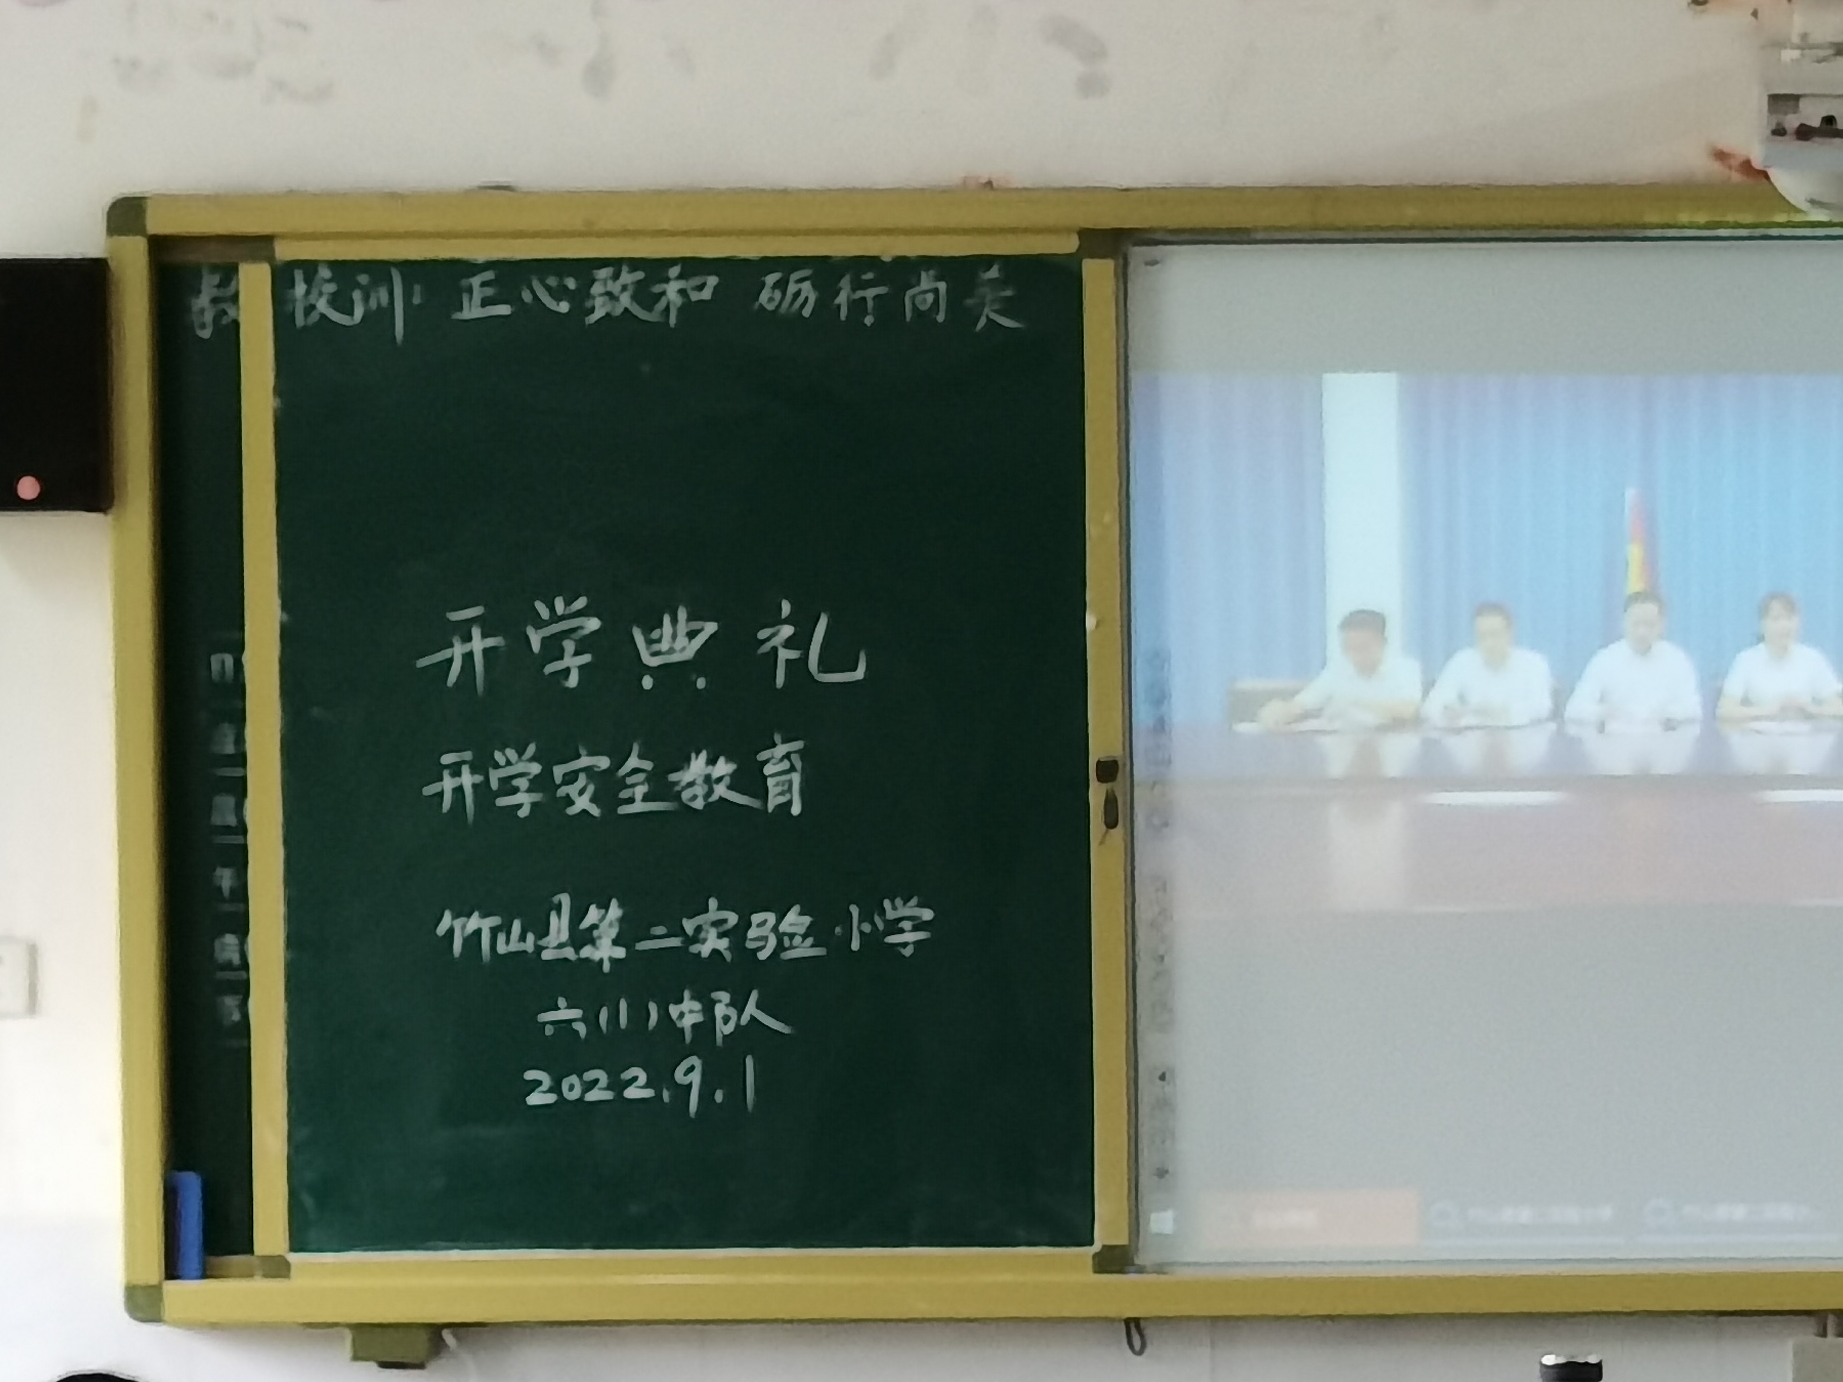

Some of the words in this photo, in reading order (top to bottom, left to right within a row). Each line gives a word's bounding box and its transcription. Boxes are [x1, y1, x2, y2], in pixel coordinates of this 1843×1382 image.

[415, 595, 867, 696] 开学典礼
[421, 732, 806, 826] 开学安全教育
[435, 893, 935, 974] 竹山县第二实验小学
[523, 1055, 756, 1118] 2022.9.1
